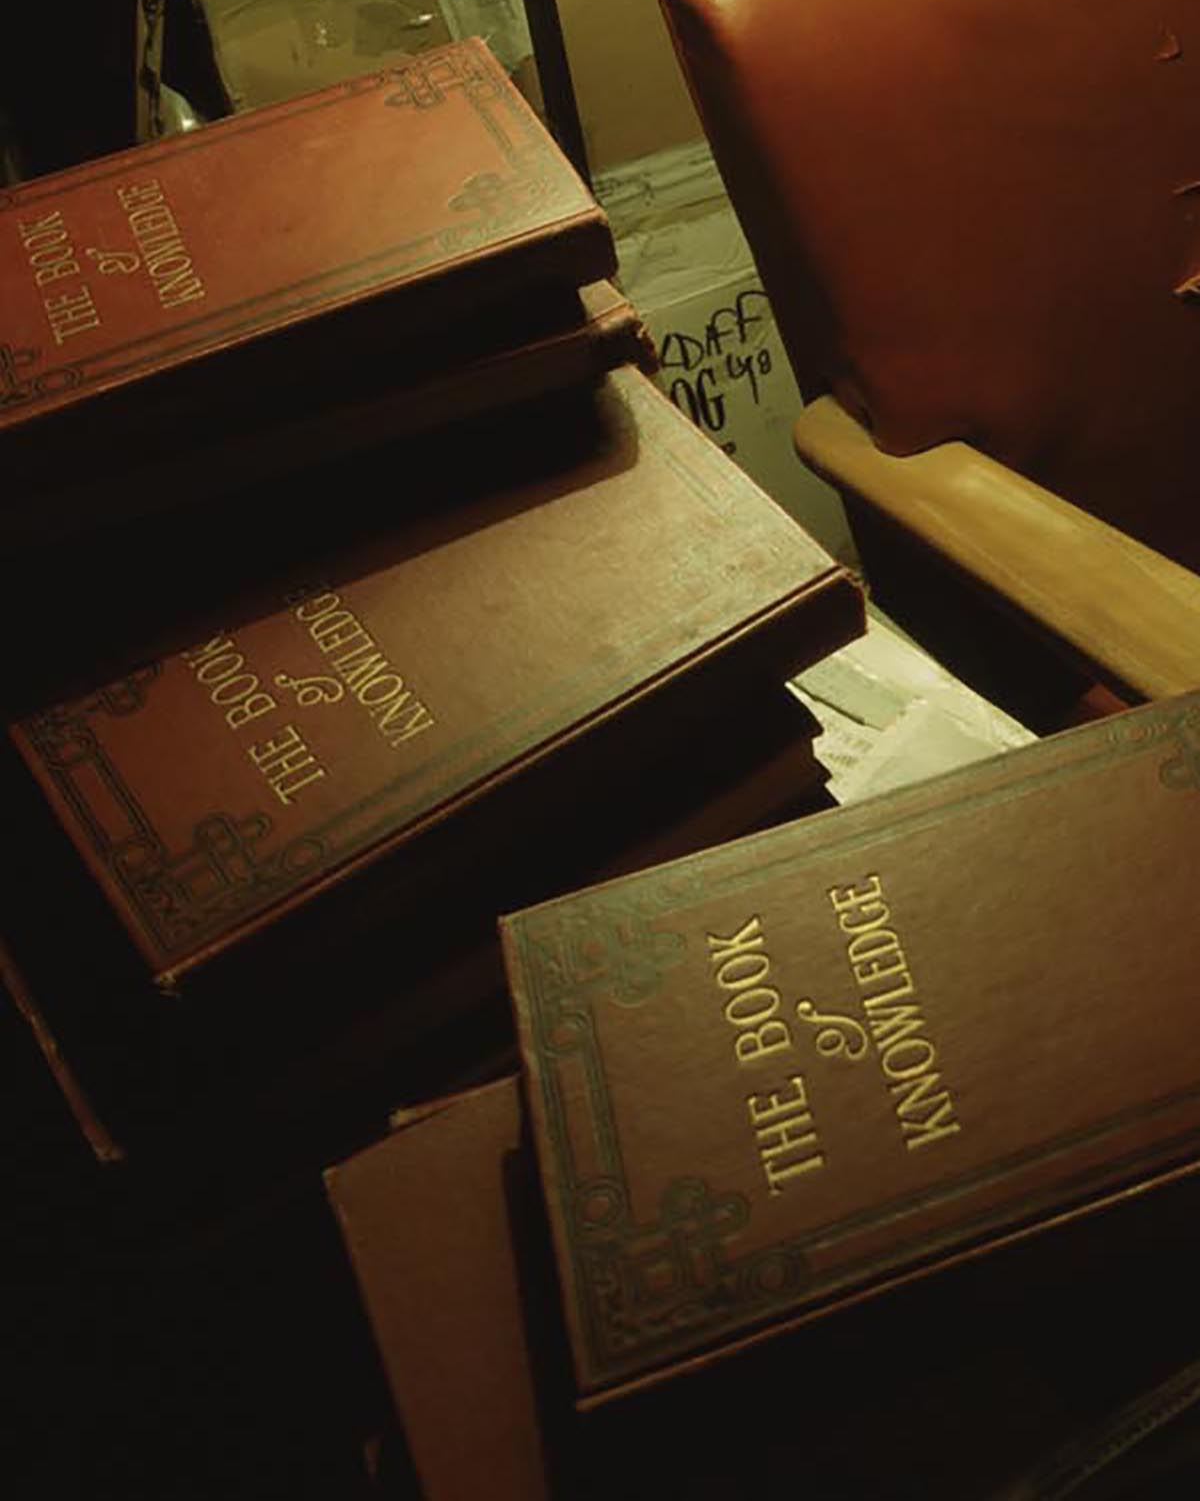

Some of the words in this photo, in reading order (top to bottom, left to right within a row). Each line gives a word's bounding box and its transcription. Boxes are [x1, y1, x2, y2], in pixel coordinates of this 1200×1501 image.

[17, 211, 80, 286] BOOK
[116, 178, 206, 309] KNOWLEDGE
[44, 284, 101, 346] THE
[180, 636, 277, 730] BOOK
[286, 584, 435, 748] KNOWLEDG
[248, 724, 326, 806] THE
[705, 914, 793, 1063] BOOK
[828, 873, 961, 1151] KNOWLEDGE
[747, 1074, 825, 1196] THE
